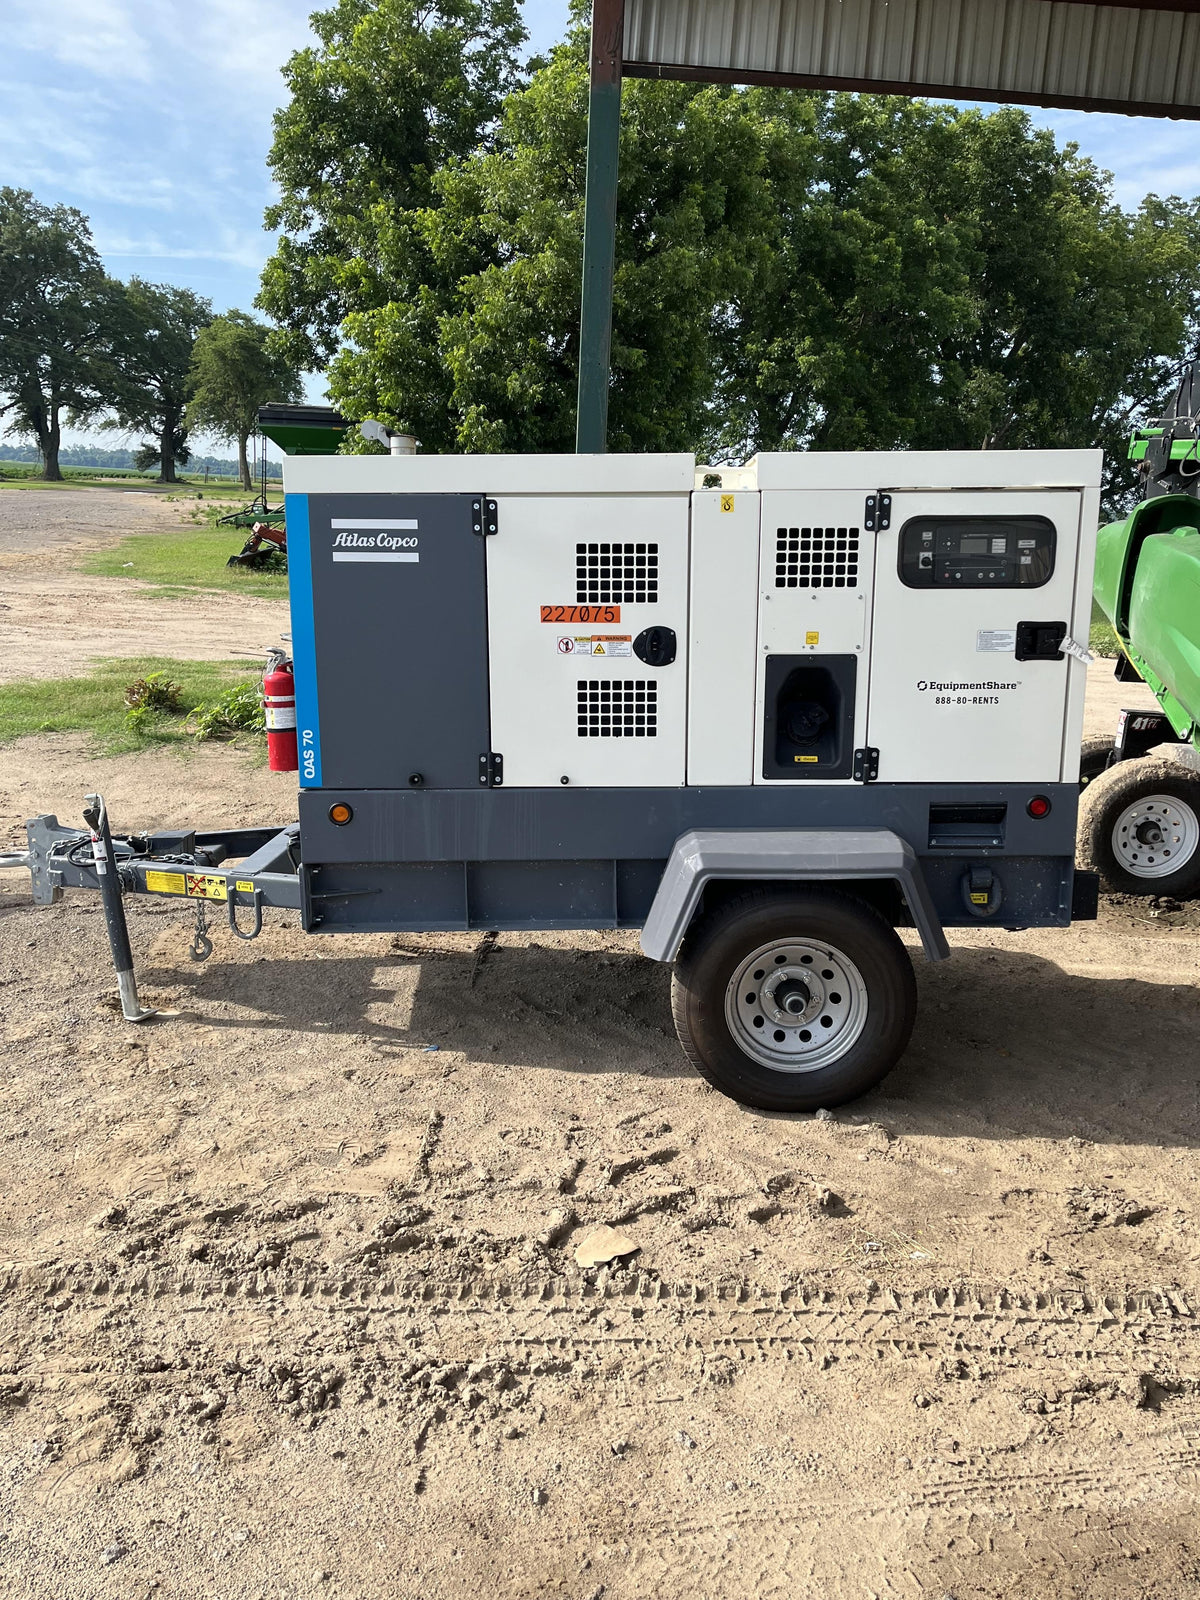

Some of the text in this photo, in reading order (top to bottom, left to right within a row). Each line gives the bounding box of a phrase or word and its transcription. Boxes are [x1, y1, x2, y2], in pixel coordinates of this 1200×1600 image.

[332, 532, 418, 550] Atlas Copco
[542, 605, 615, 622] 227075
[929, 681, 1017, 691] EquipmentShare
[935, 696, 999, 704] 888-80-RENTS
[302, 729, 316, 779] QAS 70
